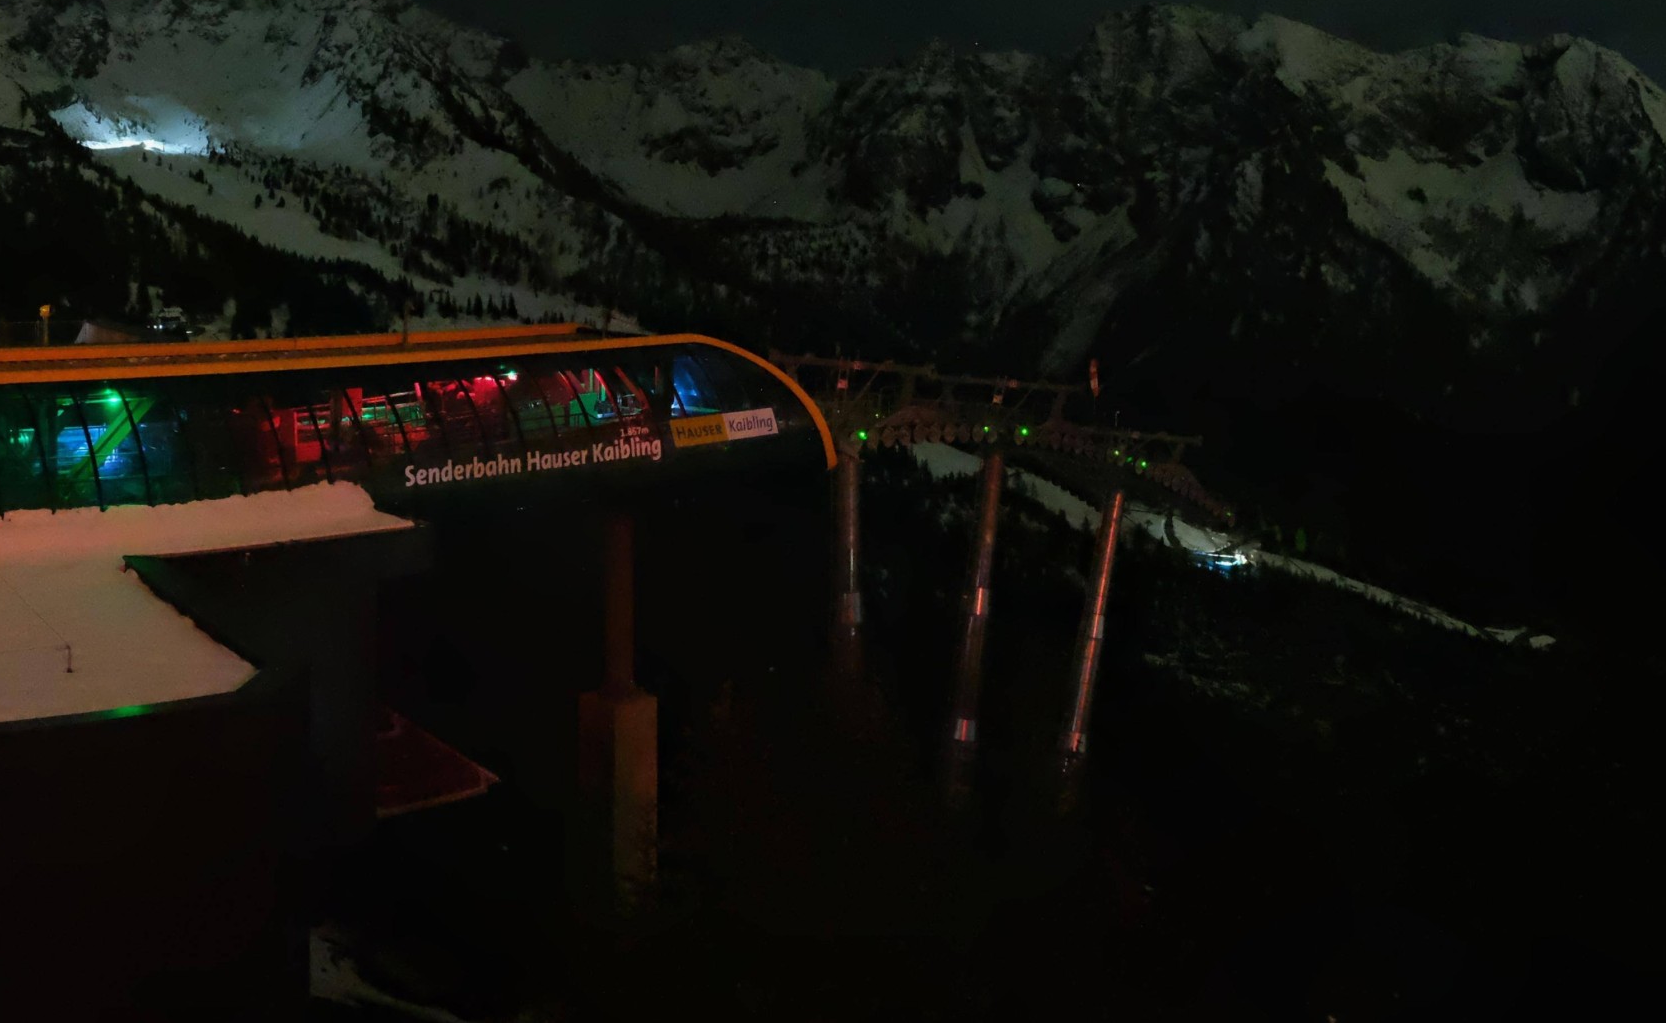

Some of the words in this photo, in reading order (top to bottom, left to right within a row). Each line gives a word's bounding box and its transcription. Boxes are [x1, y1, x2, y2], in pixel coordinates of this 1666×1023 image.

[676, 424, 722, 439] HAUSER
[729, 415, 773, 432] Kaibling
[405, 453, 522, 487] Senderbahn
[526, 449, 588, 472] Hauser
[593, 436, 662, 461] Kaibling
